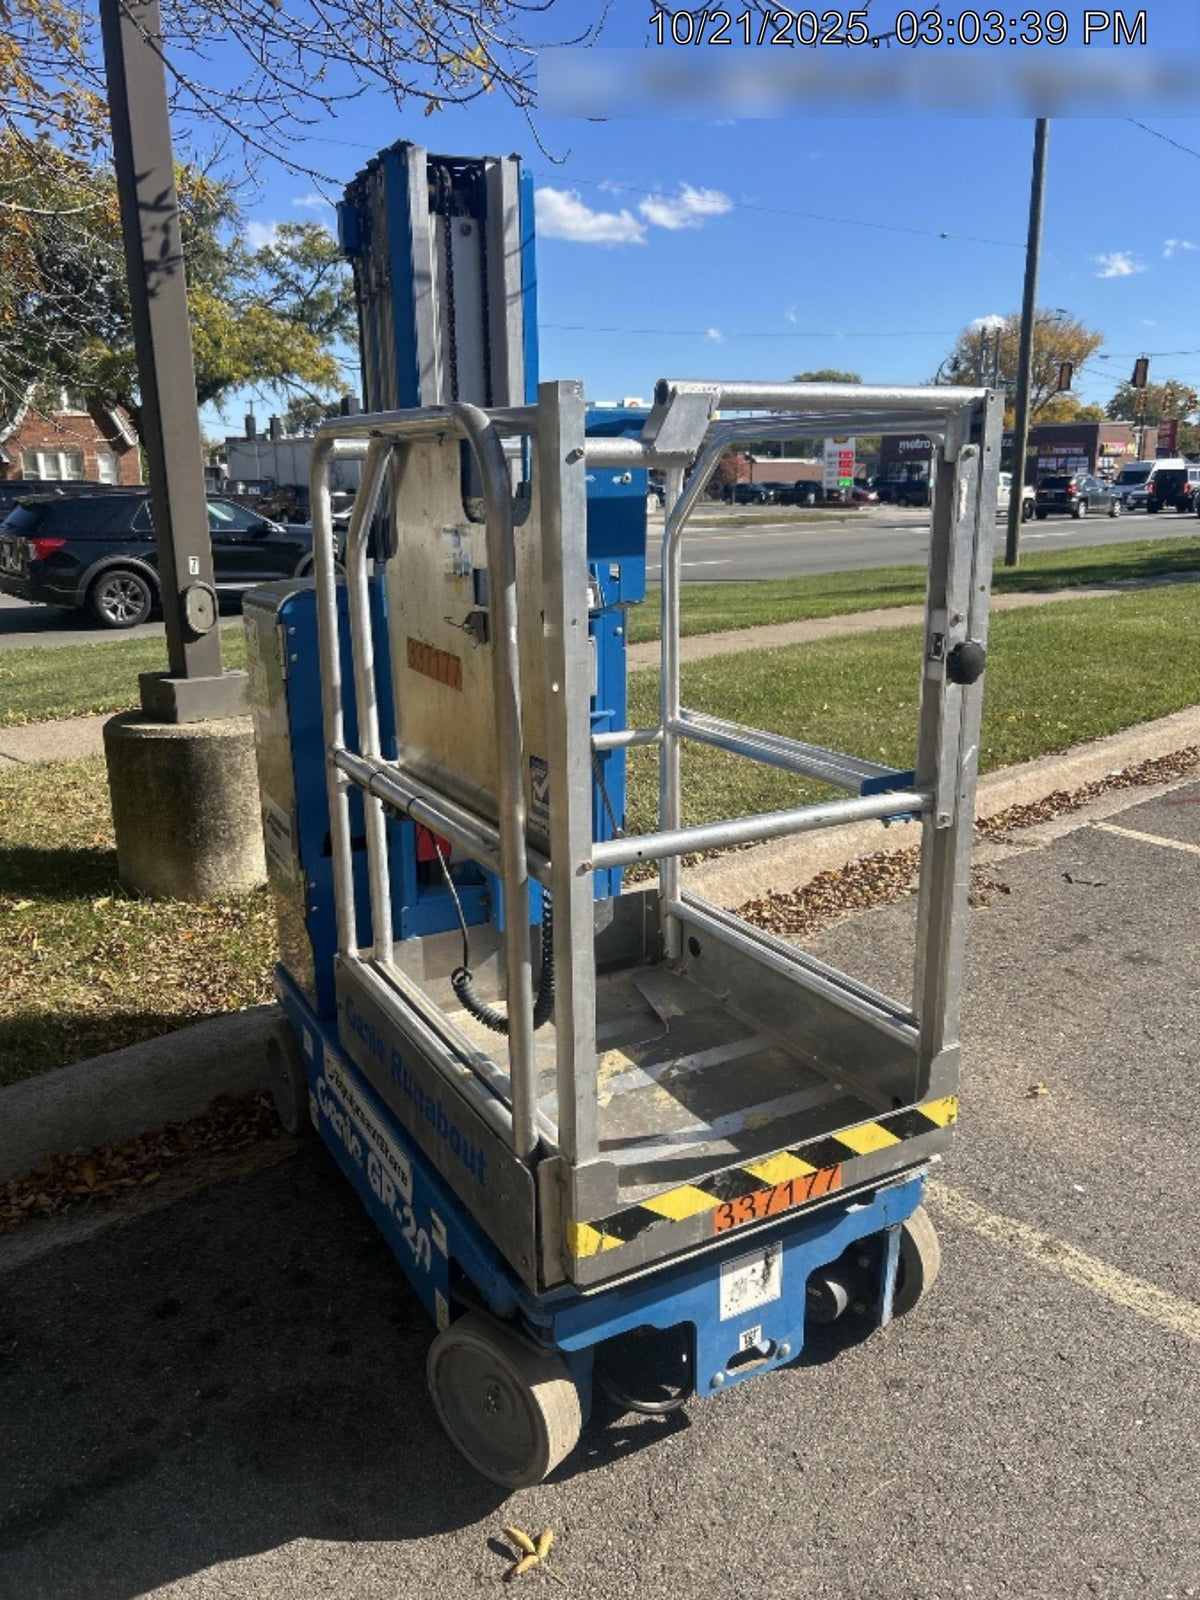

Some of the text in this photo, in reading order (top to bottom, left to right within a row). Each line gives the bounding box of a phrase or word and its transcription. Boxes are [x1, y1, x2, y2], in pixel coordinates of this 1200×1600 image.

[899, 438, 931, 449] metro
[316, 1076, 363, 1166] Genie
[345, 993, 487, 1187] Genie Runabout
[715, 1165, 838, 1231] 337177
